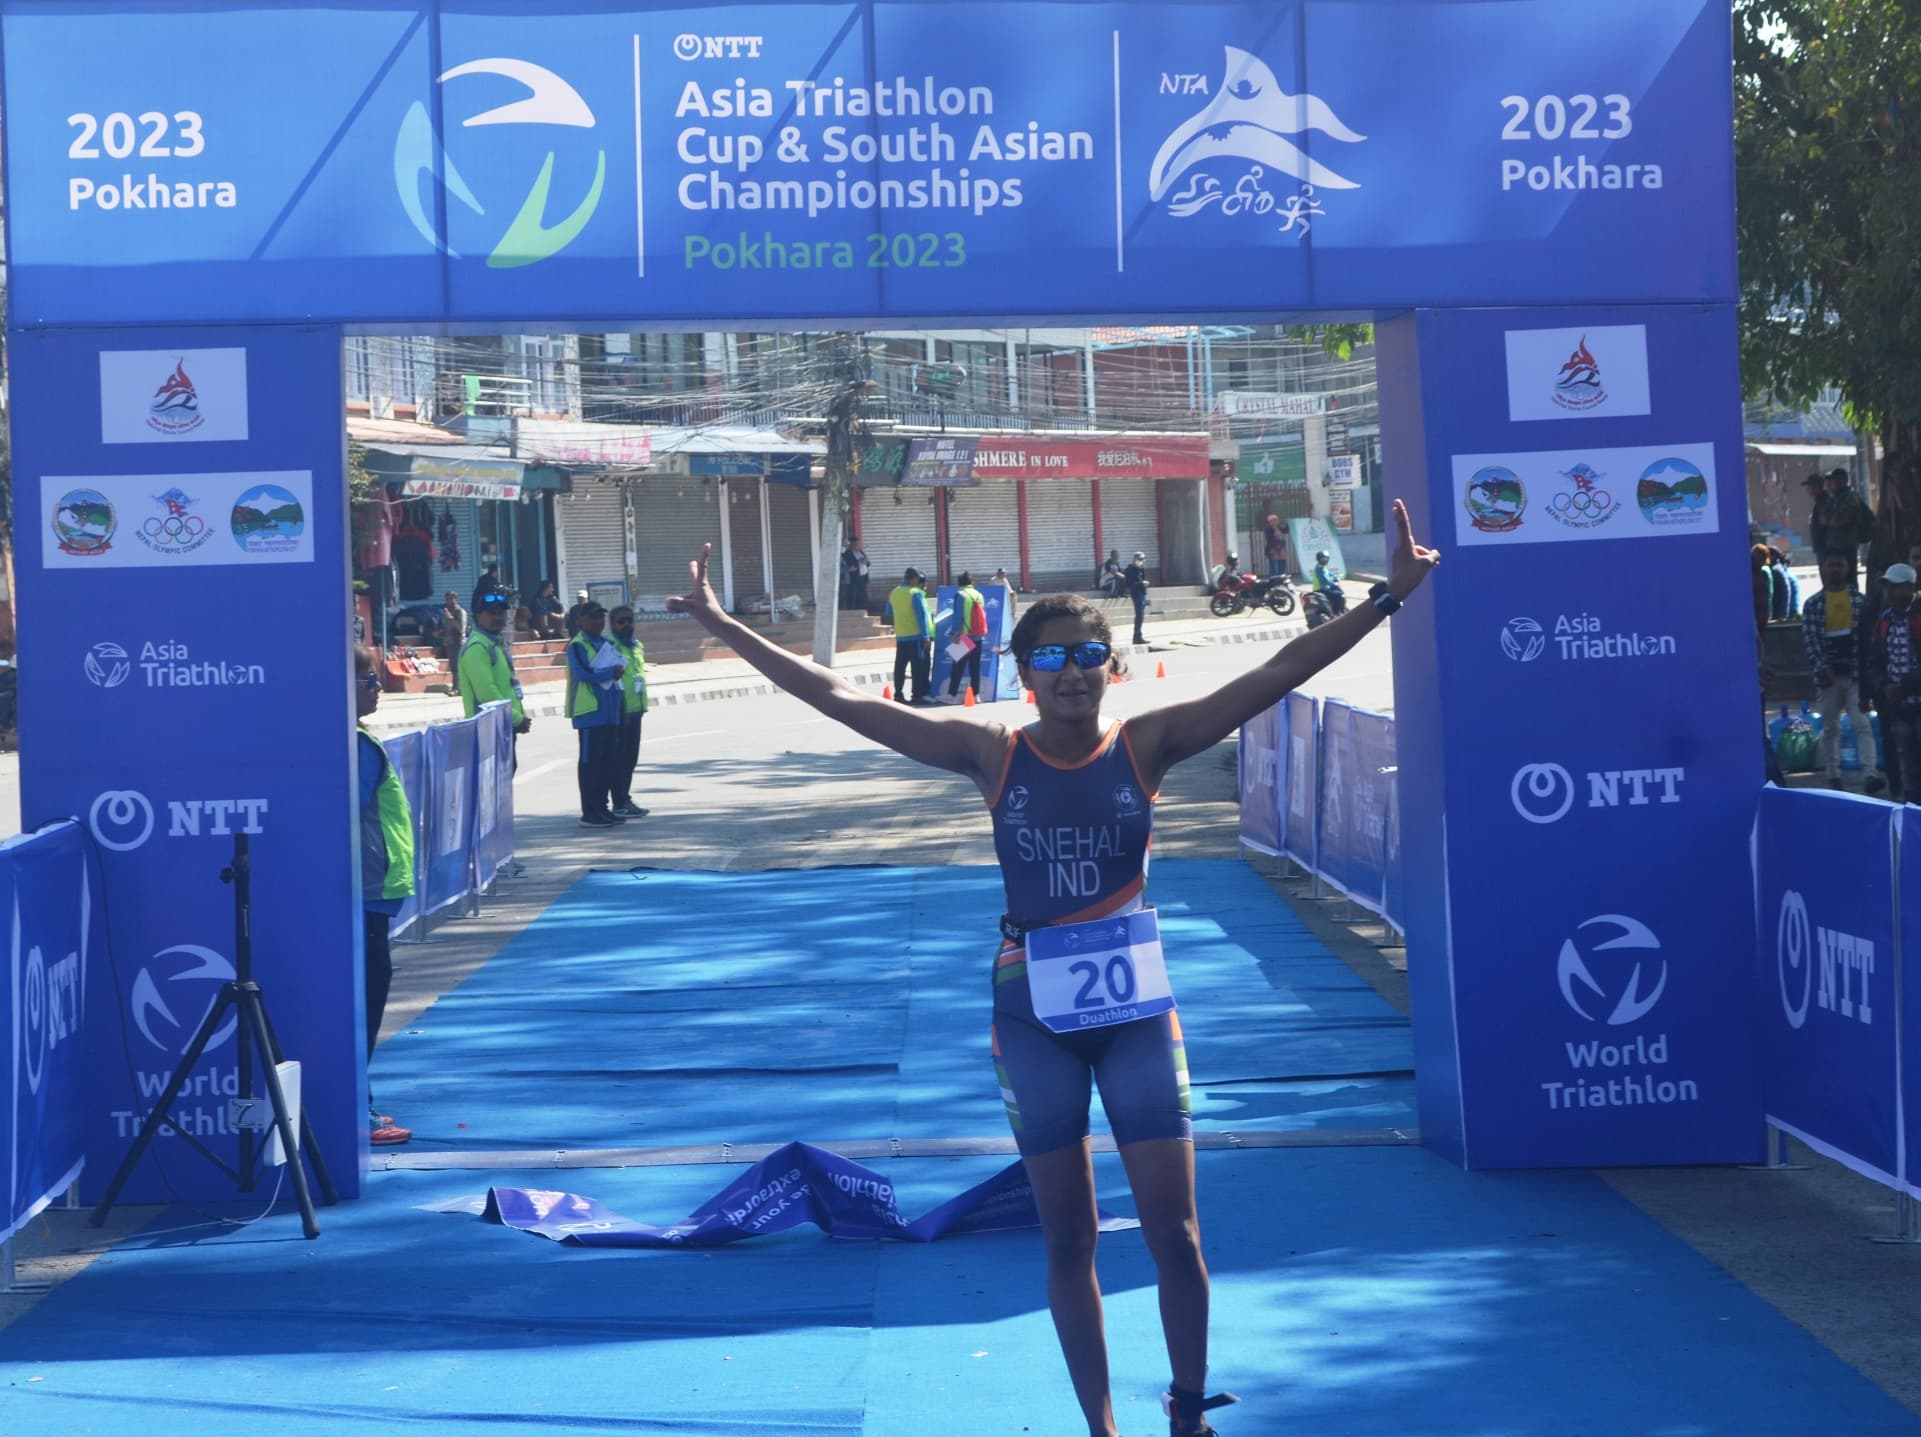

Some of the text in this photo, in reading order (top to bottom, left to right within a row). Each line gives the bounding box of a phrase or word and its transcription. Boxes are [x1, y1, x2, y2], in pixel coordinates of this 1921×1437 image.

[704, 36, 763, 58] NTT
[675, 76, 993, 118] Asia Triathlon
[1160, 73, 1209, 95] NTA
[1501, 94, 1632, 140] 2023
[67, 111, 205, 159] 2023
[676, 122, 1093, 172] Cup & South Asian
[1502, 156, 1663, 190] Pokhara
[69, 174, 237, 210] Pokhara
[678, 169, 1023, 217] Championships
[685, 232, 966, 270] Pokhara 2023
[1031, 456, 1041, 467] IN
[1045, 456, 1068, 467] LOVE
[153, 543, 181, 554] OLYMPIC
[182, 527, 215, 553] COMMITTEE
[1555, 612, 1600, 634] Asia
[140, 640, 188, 661] Asia
[1555, 632, 1676, 660] Triathlon
[140, 661, 265, 687] Triathlon
[1587, 768, 1684, 807] NTT
[168, 799, 268, 836] NTT
[1017, 824, 1126, 861] SNEHAL
[1049, 861, 1100, 897] IND
[1068, 955, 1135, 1009] 20
[1818, 926, 1874, 1024] NTT
[1080, 1007, 1138, 1025] Duathlon
[1565, 1034, 1668, 1067] World
[1542, 1074, 1698, 1108] Triathlon
[111, 1106, 264, 1138] Trathl
[726, 1168, 801, 1226] extraordi
[752, 1197, 791, 1229] your
